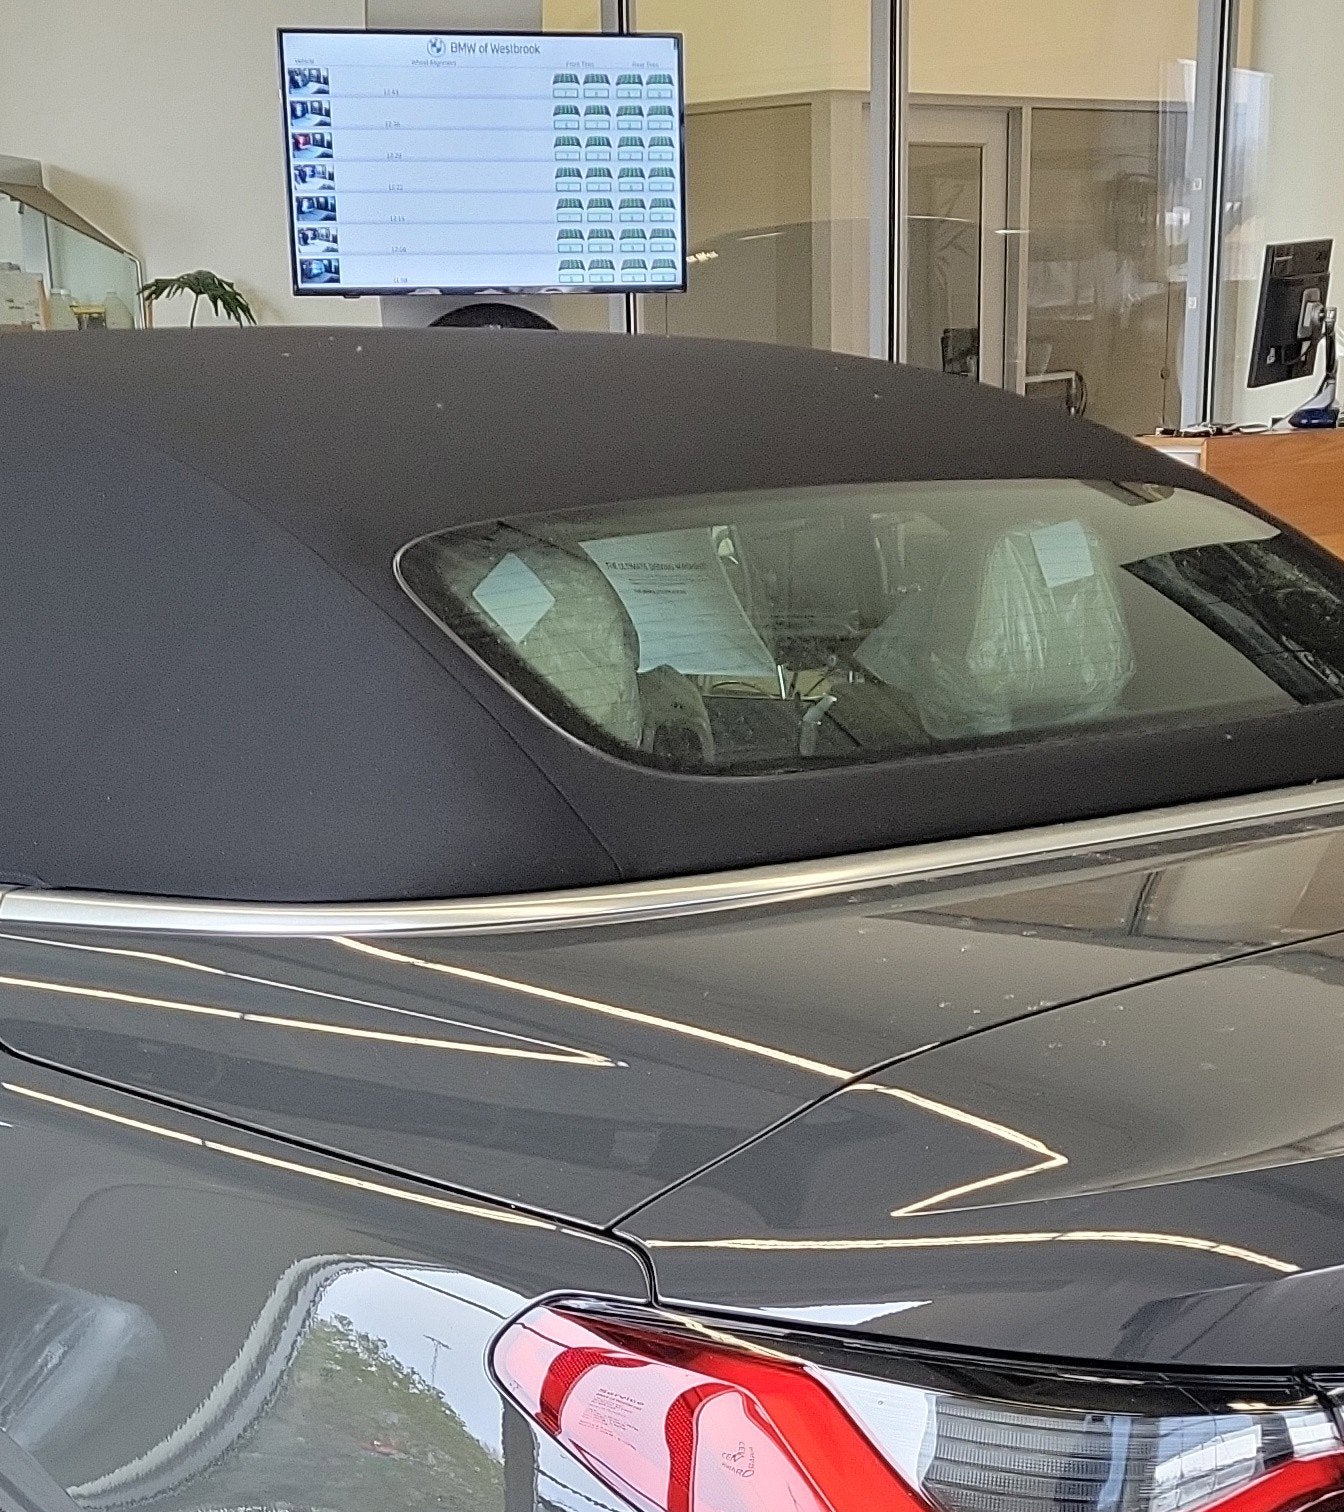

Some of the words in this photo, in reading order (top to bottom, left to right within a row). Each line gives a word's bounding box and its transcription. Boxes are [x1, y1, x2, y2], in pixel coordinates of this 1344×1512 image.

[450, 42, 476, 54] BMW
[478, 42, 488, 54] of
[490, 42, 541, 55] Westbrook
